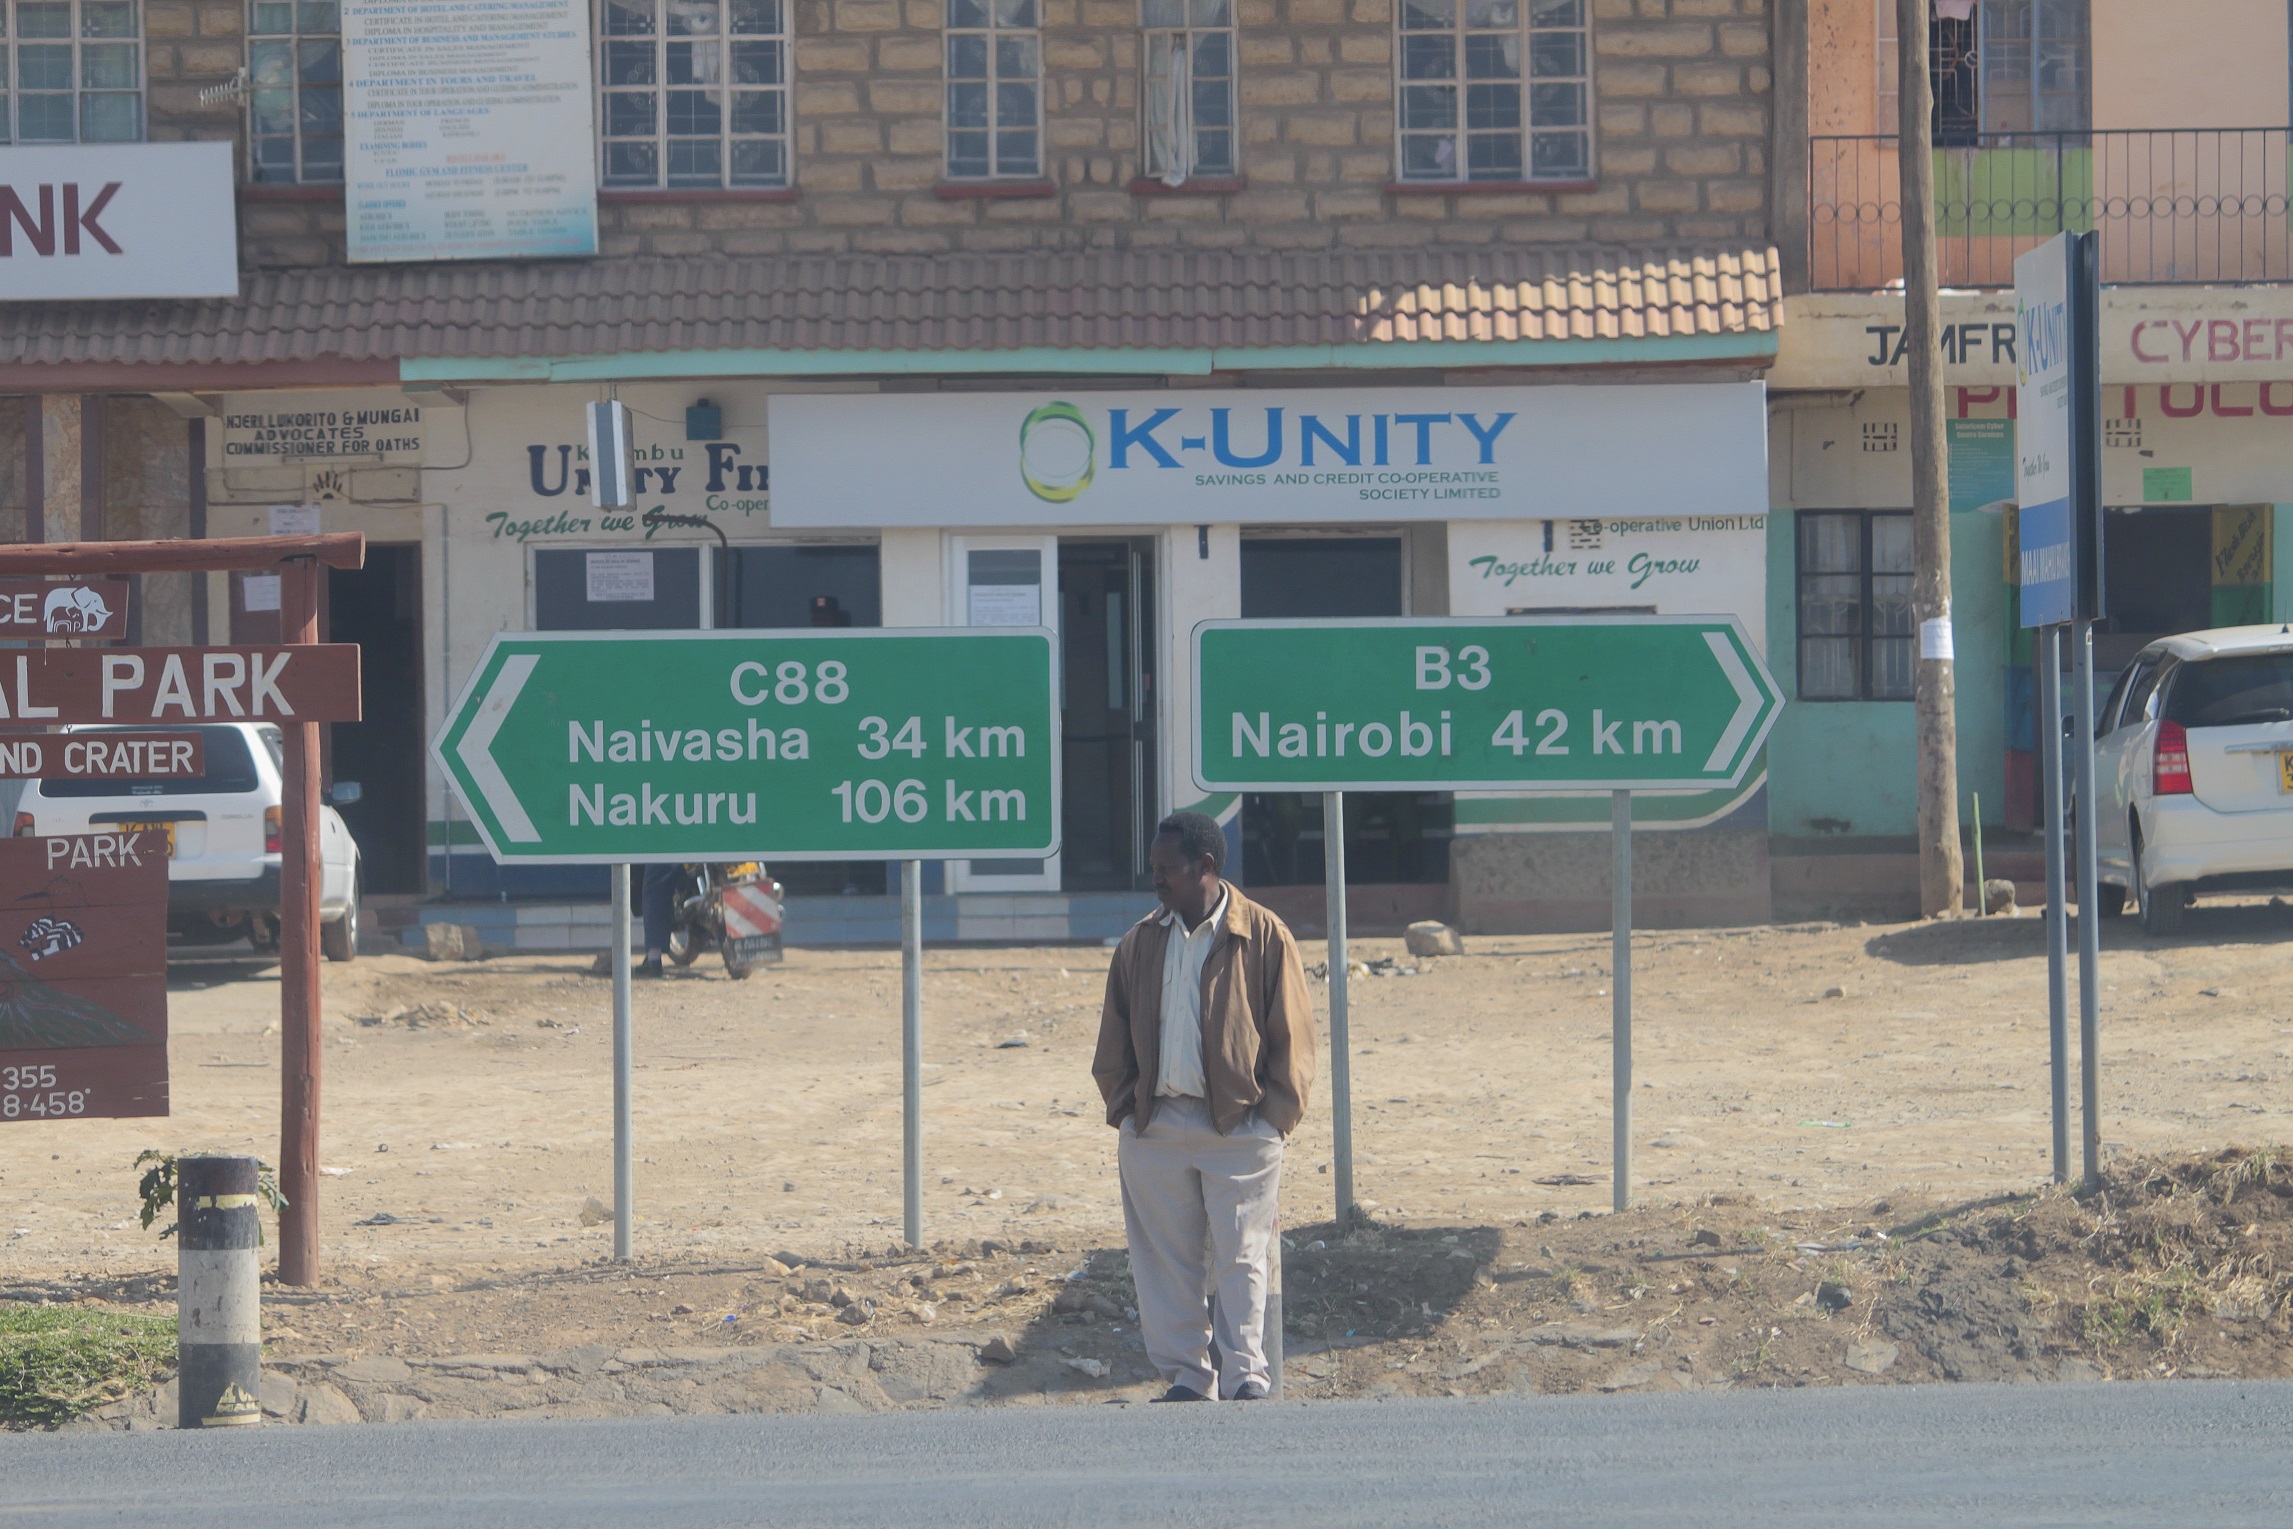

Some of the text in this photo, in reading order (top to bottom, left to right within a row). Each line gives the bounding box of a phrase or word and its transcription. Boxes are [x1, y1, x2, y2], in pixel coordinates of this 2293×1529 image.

[353, 6, 406, 15] DEPARTMENT
[364, 16, 413, 26] CERTIFICATE
[415, 16, 424, 24] IN
[364, 26, 402, 36] DIPLOMA
[404, 25, 412, 34] IN
[353, 36, 406, 46] DEPARTMENT
[356, 78, 424, 87] DEPARTMENT
[426, 77, 437, 86] IN
[440, 76, 473, 85] TOURS
[369, 69, 407, 77] DIPLOMA
[358, 109, 418, 119] DEPARTMENT
[420, 108, 431, 116] OF
[367, 100, 397, 109] DIPLOMA
[360, 142, 399, 151] EXAMINING
[269, 411, 337, 427] LUKORITO
[343, 409, 354, 425] &
[356, 406, 421, 425] MUNGAI
[254, 426, 365, 441] ADVOCATES
[1107, 407, 1517, 469] K-UNITY
[225, 436, 421, 456] COMMISSIONER FOR OATHS
[1194, 471, 1500, 487] SAVINGS AND CREDIT CO-OPERATIVE
[1360, 487, 1501, 501] SOCIETY LIMITED
[485, 511, 591, 544] Together
[600, 514, 635, 532] we
[1688, 517, 1735, 532] Union
[1738, 515, 1764, 531] Ltd
[1469, 552, 1701, 590] Together we Grow
[1415, 645, 1492, 691] B3
[101, 652, 296, 719] PARK
[729, 660, 851, 706] C88
[568, 715, 1026, 764] Naivasha 34 km
[1231, 708, 1682, 758] Nairobi 42 km
[64, 740, 195, 774] CRATER
[568, 778, 1027, 826] Nakuru 106 km
[46, 832, 143, 871] PARK
[2, 1064, 57, 1091] 355
